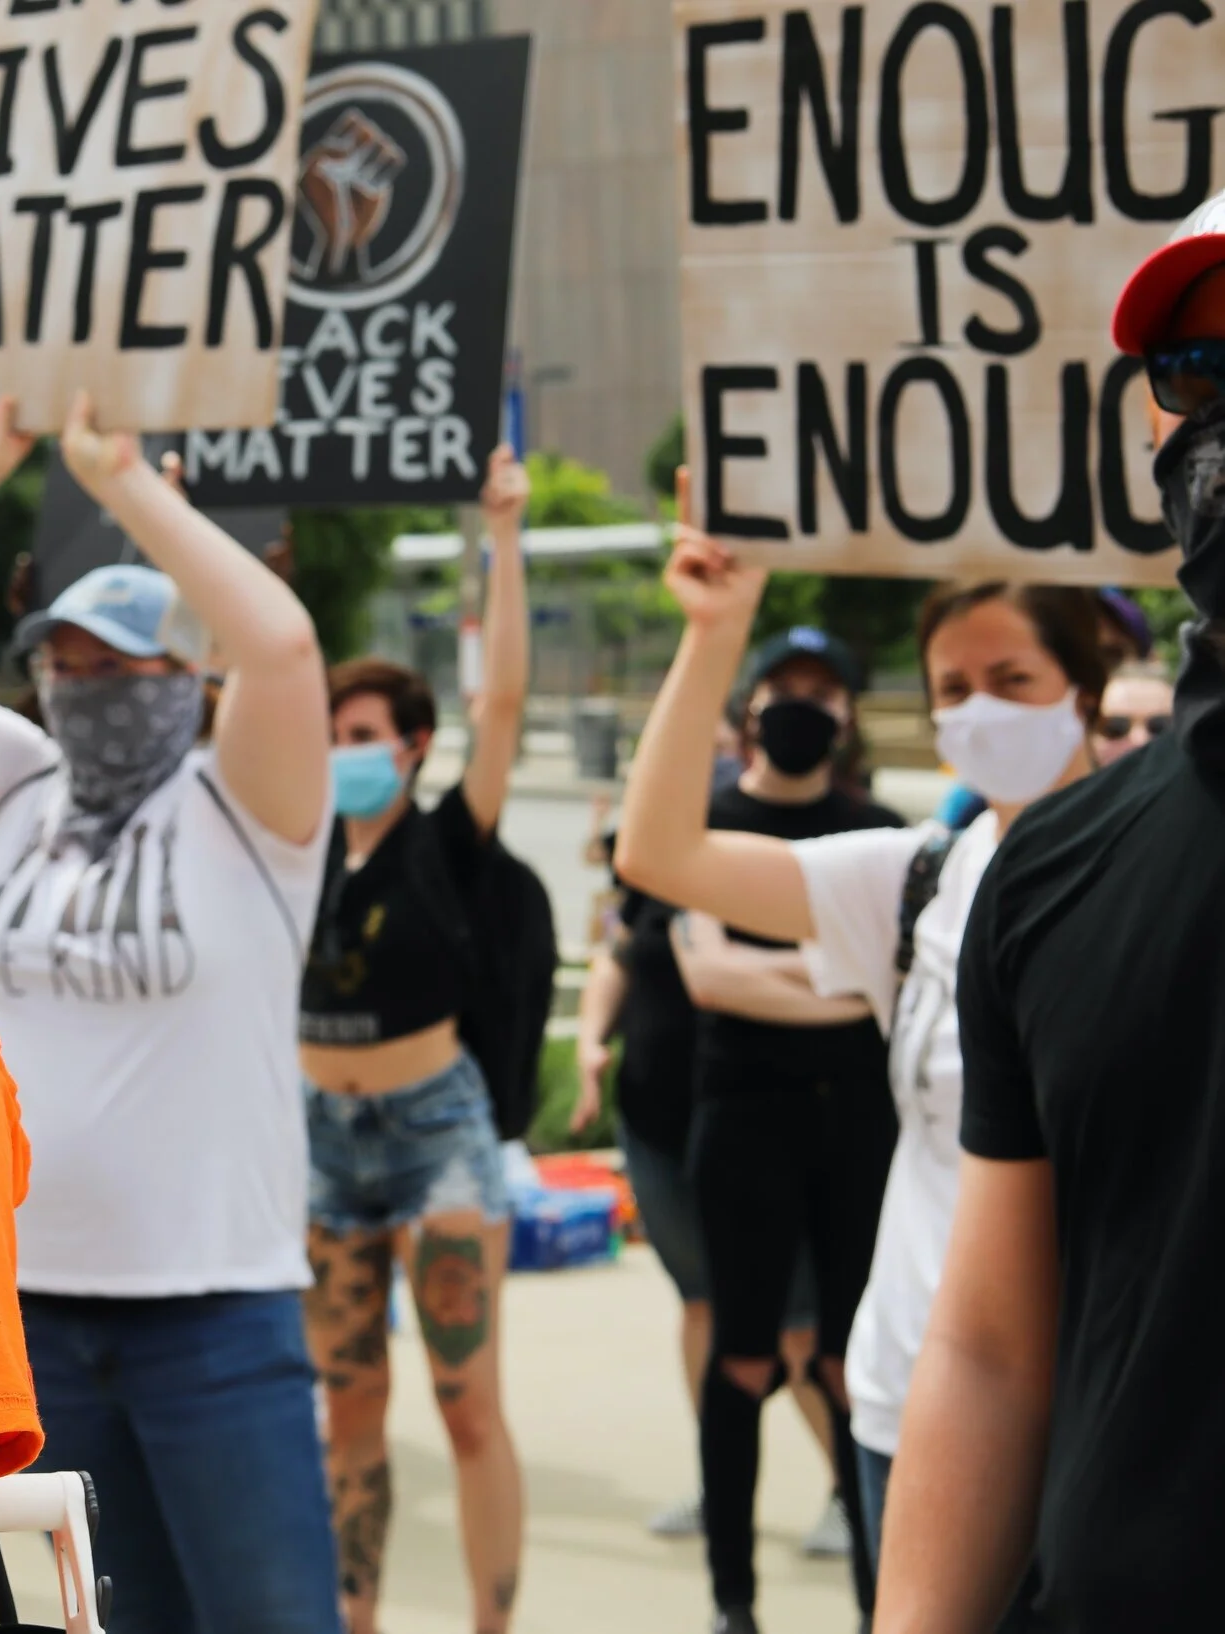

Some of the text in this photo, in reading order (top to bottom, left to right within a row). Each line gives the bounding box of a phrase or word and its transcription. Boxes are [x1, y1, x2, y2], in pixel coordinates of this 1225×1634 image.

[894, 223, 1041, 355] IS
[280, 302, 458, 360] ACK
[185, 415, 476, 486] MATTER
